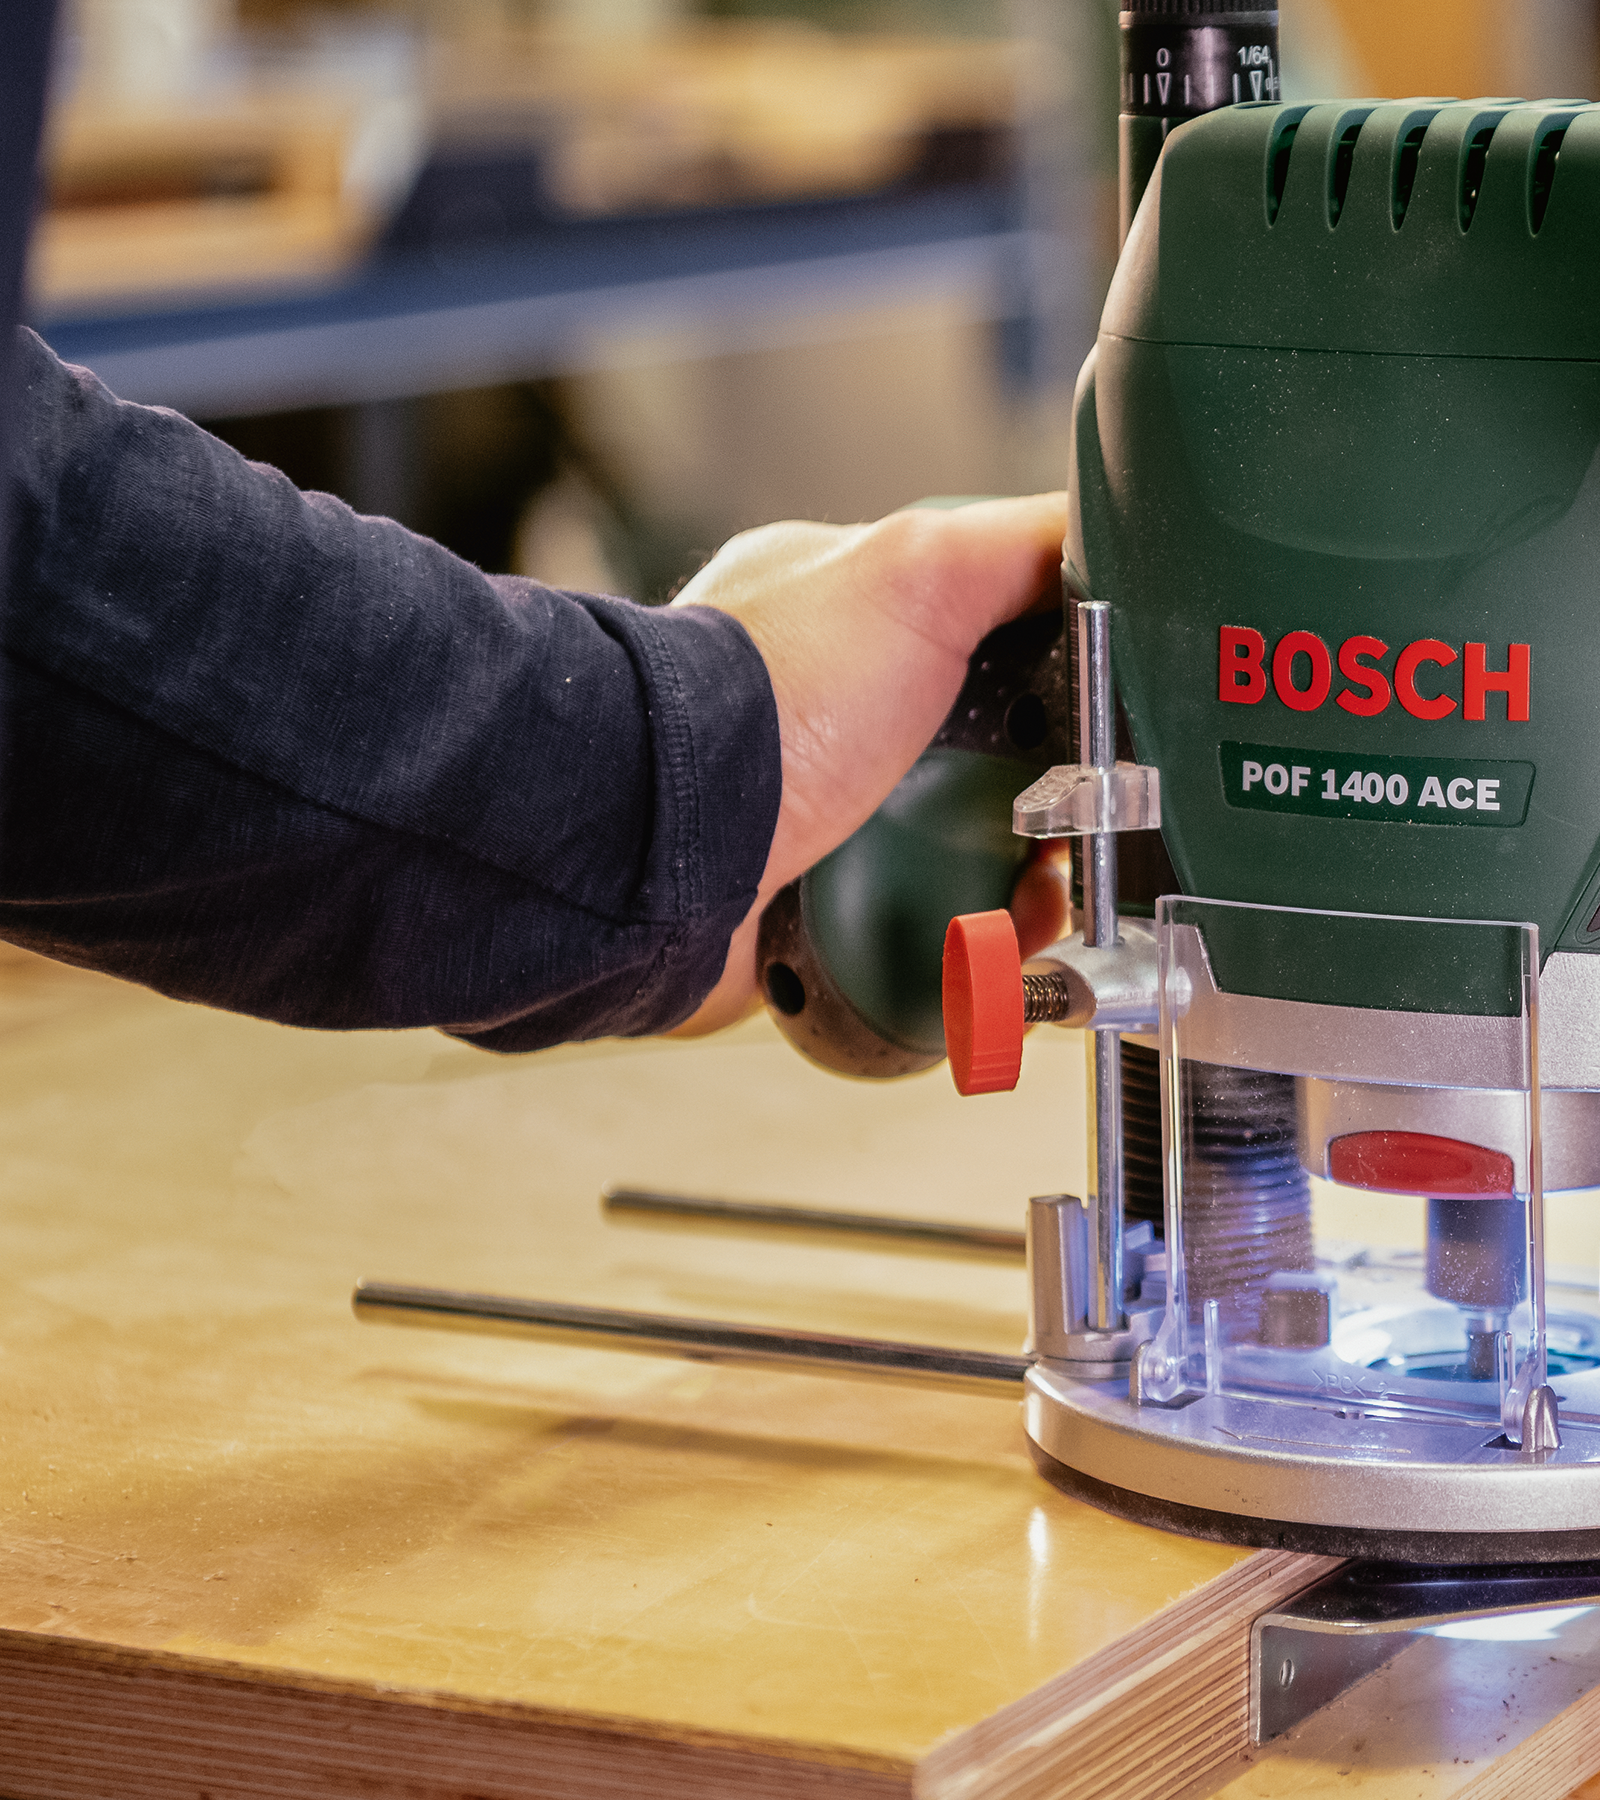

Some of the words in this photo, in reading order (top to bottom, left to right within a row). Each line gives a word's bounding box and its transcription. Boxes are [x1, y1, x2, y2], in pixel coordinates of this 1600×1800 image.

[1157, 48, 1171, 66] 0
[1238, 45, 1271, 66] 1/64
[1219, 625, 1531, 722] BOSCH
[1242, 761, 1311, 797] POF
[1321, 769, 1409, 806] 1400
[1417, 776, 1501, 811] ACE
